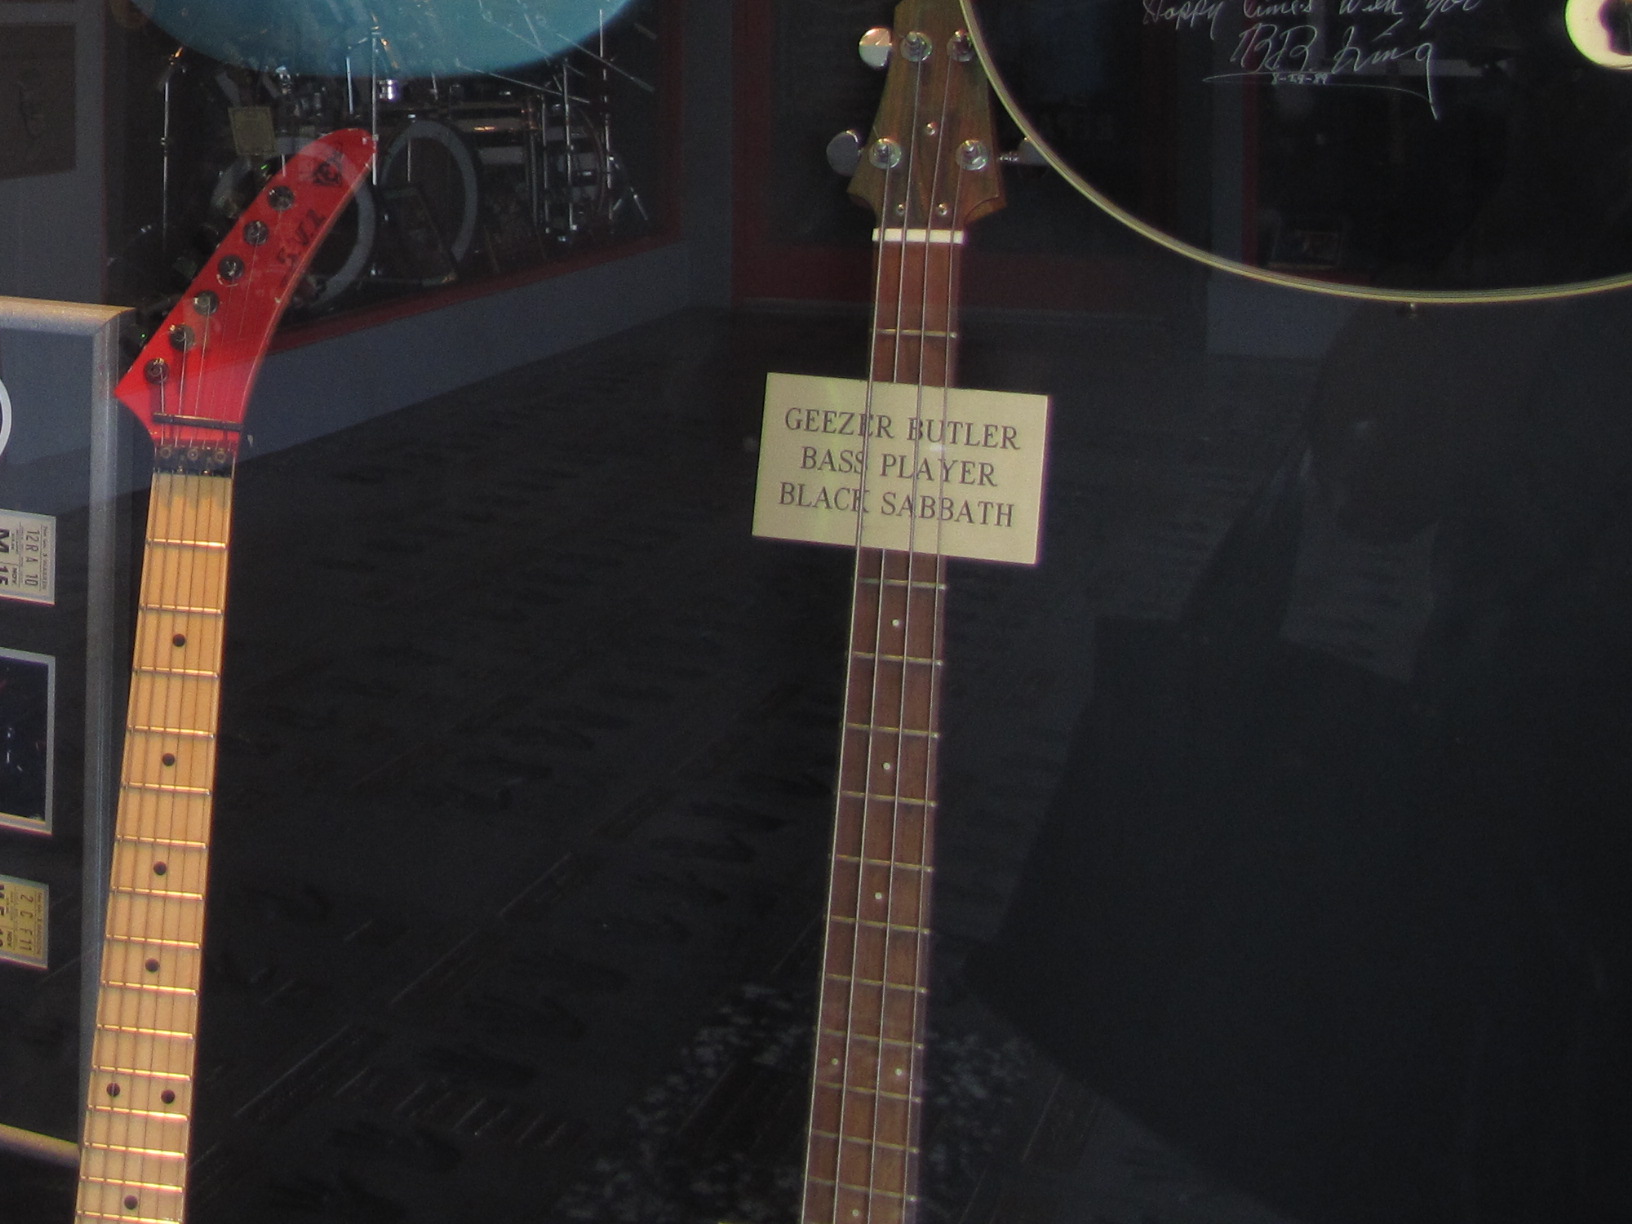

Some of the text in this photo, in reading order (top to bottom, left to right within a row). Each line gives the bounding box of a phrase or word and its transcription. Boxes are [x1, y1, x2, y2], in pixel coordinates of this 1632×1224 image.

[784, 407, 1021, 450] GEEZER BUTLER
[800, 446, 999, 488] BASS PLAYER
[778, 481, 1016, 528] BLACK SABBATH
